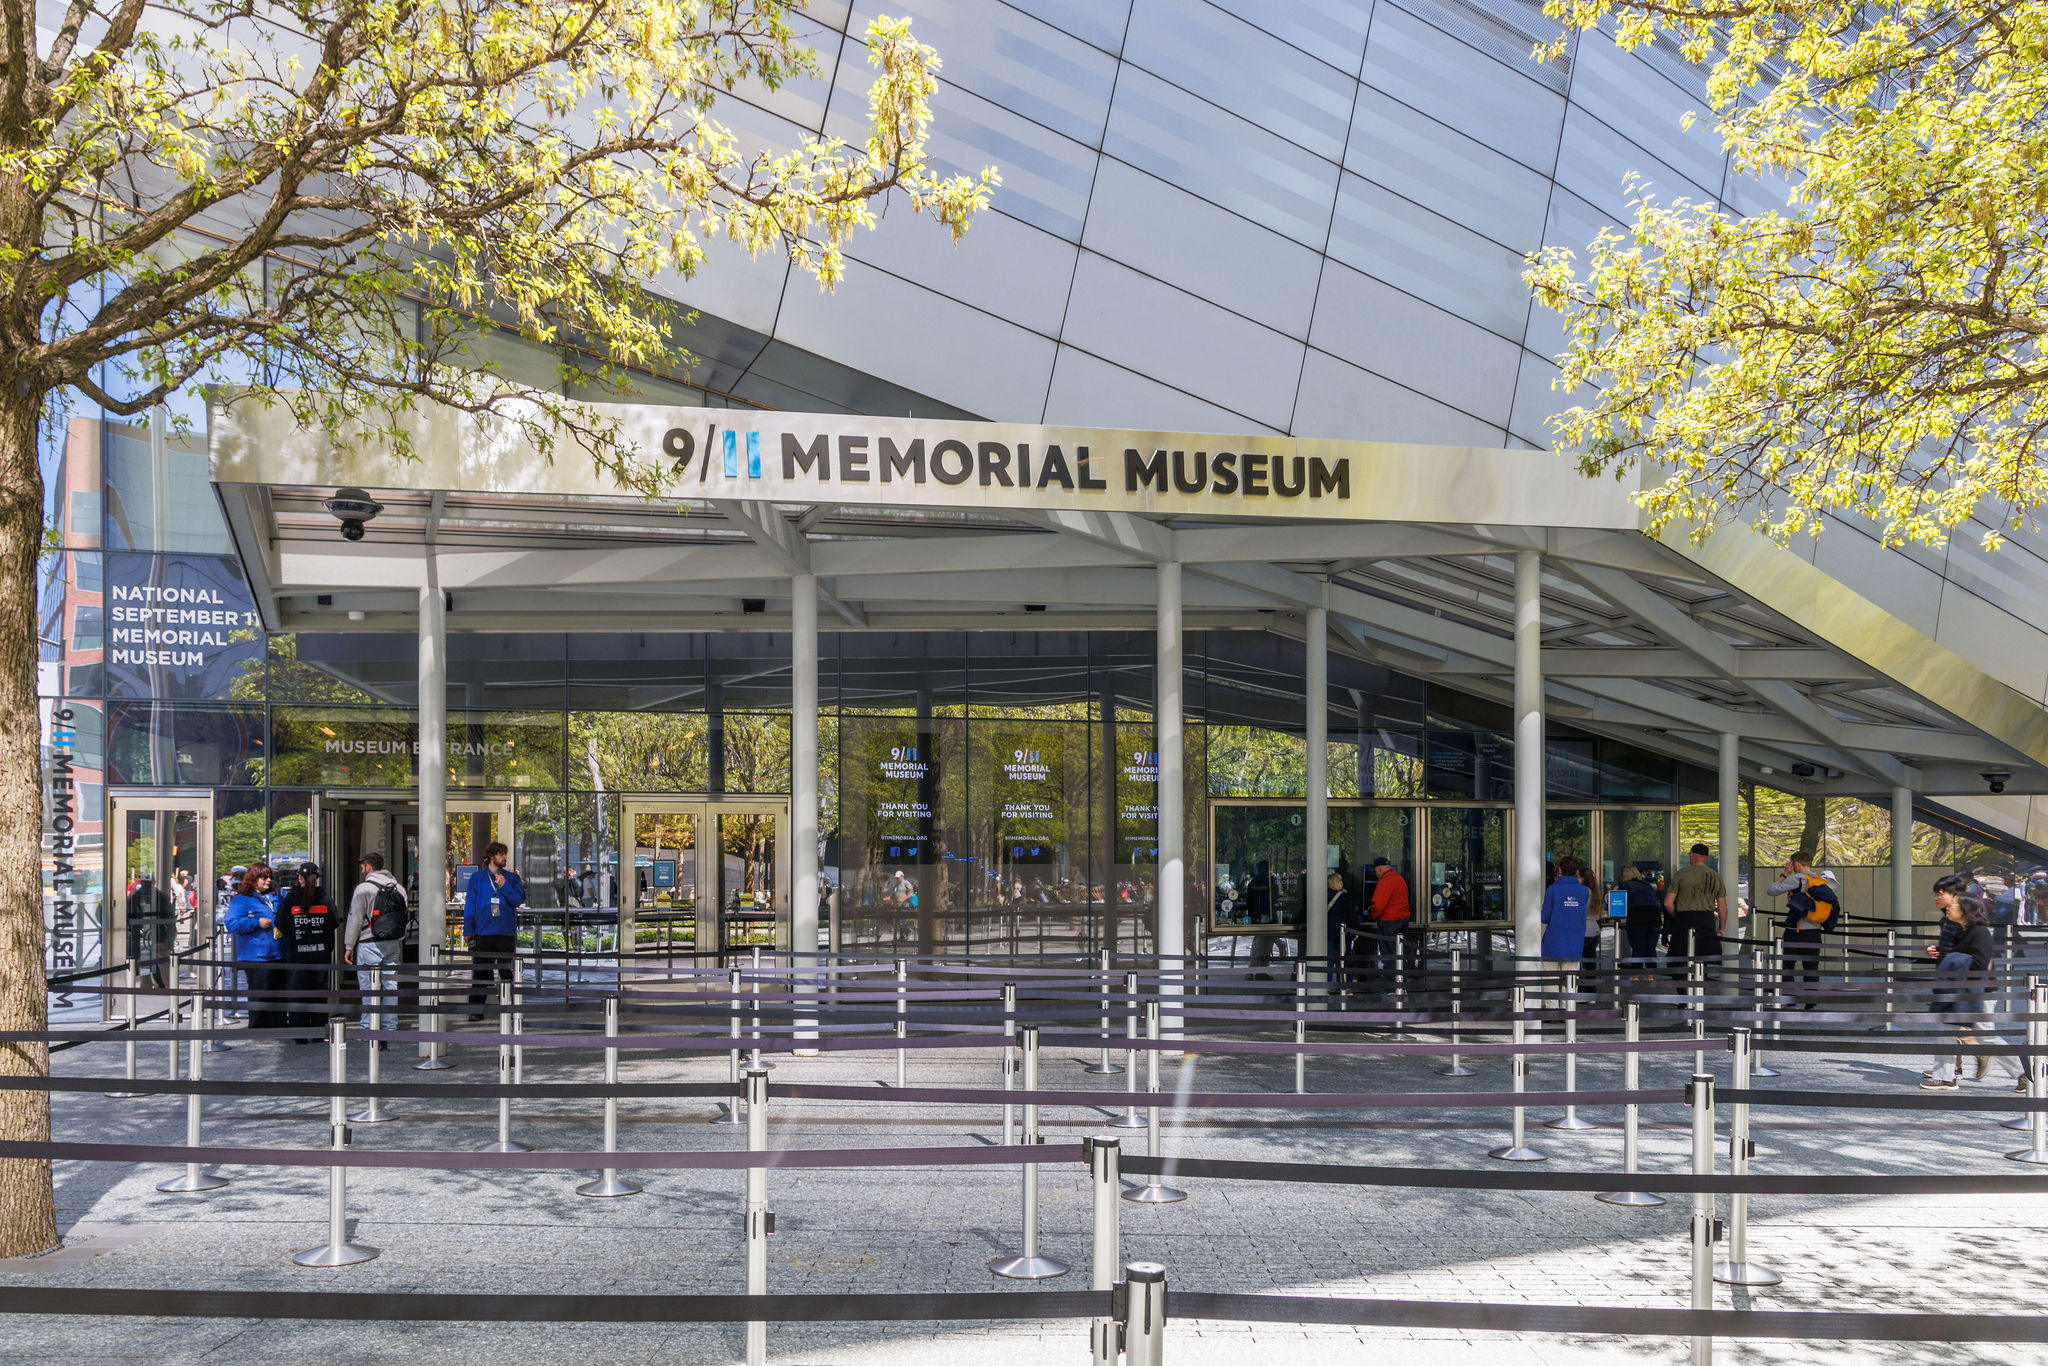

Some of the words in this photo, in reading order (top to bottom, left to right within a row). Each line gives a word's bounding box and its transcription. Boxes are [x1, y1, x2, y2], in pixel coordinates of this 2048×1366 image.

[662, 424, 761, 483] 9/11
[781, 432, 1107, 490] MEMORIAL
[1124, 448, 1350, 499] MUSEUM
[112, 585, 224, 604] NATIONAL
[112, 606, 238, 626] SEPTEMBER
[112, 628, 227, 646] MEMORIAL
[112, 649, 203, 666] MUSEUM
[51, 708, 76, 747] 9/11
[325, 740, 406, 754] MUSEUM
[413, 741, 513, 756] ERANCE
[891, 746, 917, 762] 9/11
[1014, 748, 1040, 764] 9/11
[880, 762, 928, 771] MEMORIAL
[885, 770, 924, 779] MUSEUM
[1004, 764, 1051, 772] MEMORIAL
[1124, 766, 1158, 774] MEMORI
[1009, 772, 1046, 780] MUSEUM
[1128, 774, 1159, 782] MUSEU
[53, 754, 74, 892] MEMORIAL
[1020, 811, 1054, 819] VISITING
